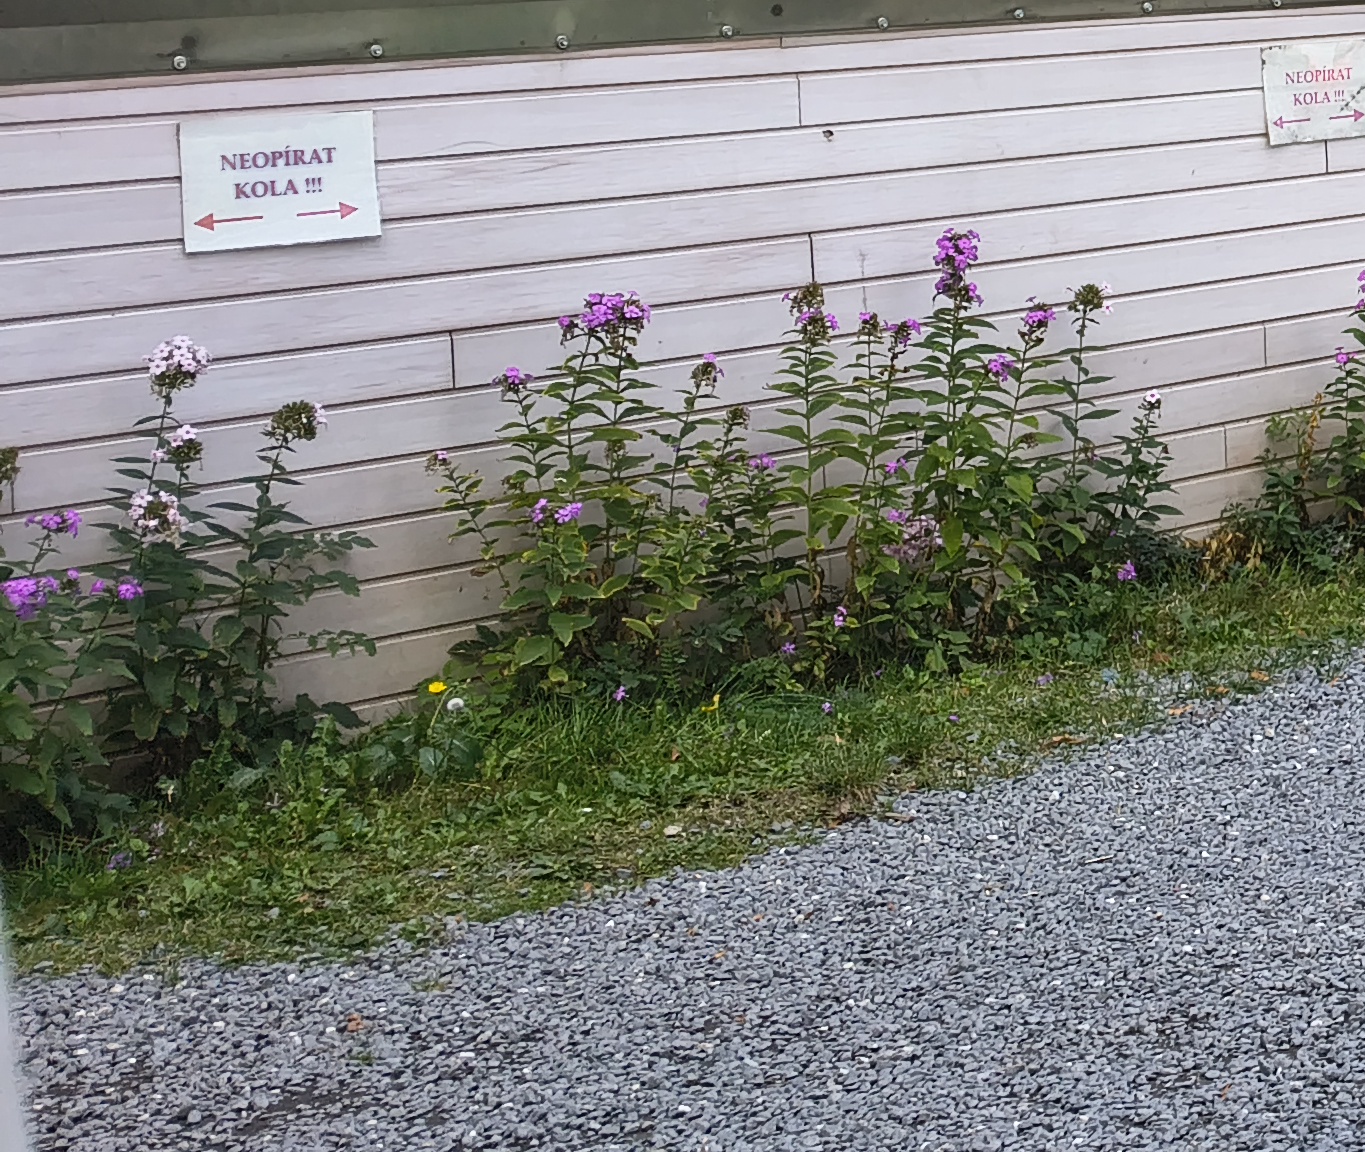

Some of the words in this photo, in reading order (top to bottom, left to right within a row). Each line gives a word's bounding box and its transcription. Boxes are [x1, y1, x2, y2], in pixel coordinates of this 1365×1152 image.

[1285, 65, 1353, 85] NEOPÍRAT
[1293, 91, 1331, 106] KOLA
[220, 145, 337, 172] NEOPÍRAT
[234, 179, 299, 200] KOLA
[304, 176, 323, 194] !!!
